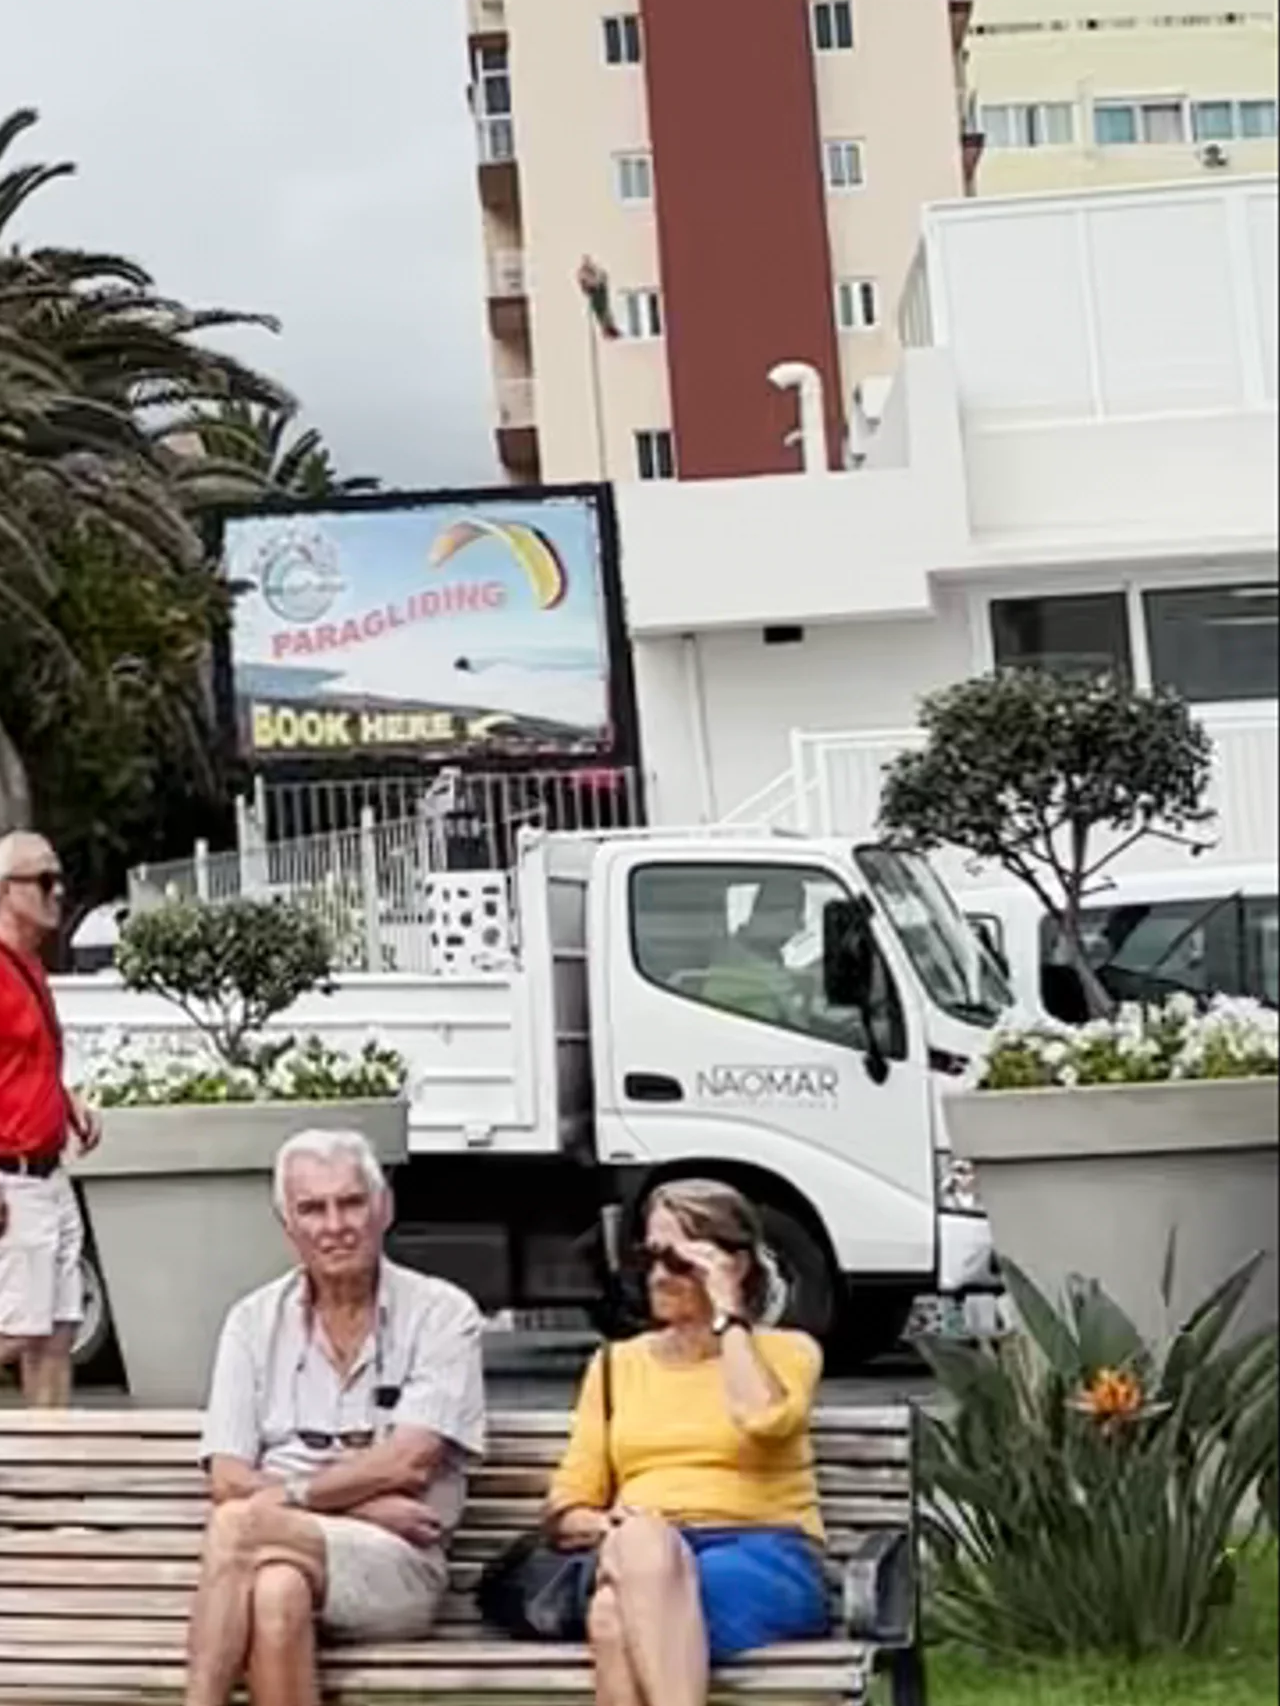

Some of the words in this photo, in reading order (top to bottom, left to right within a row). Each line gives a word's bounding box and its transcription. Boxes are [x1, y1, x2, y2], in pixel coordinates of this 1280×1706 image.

[269, 581, 509, 658] PARAGLIDING
[252, 703, 352, 747] BOOK
[359, 710, 456, 743] HERE
[696, 1064, 838, 1097] NAOMAR
